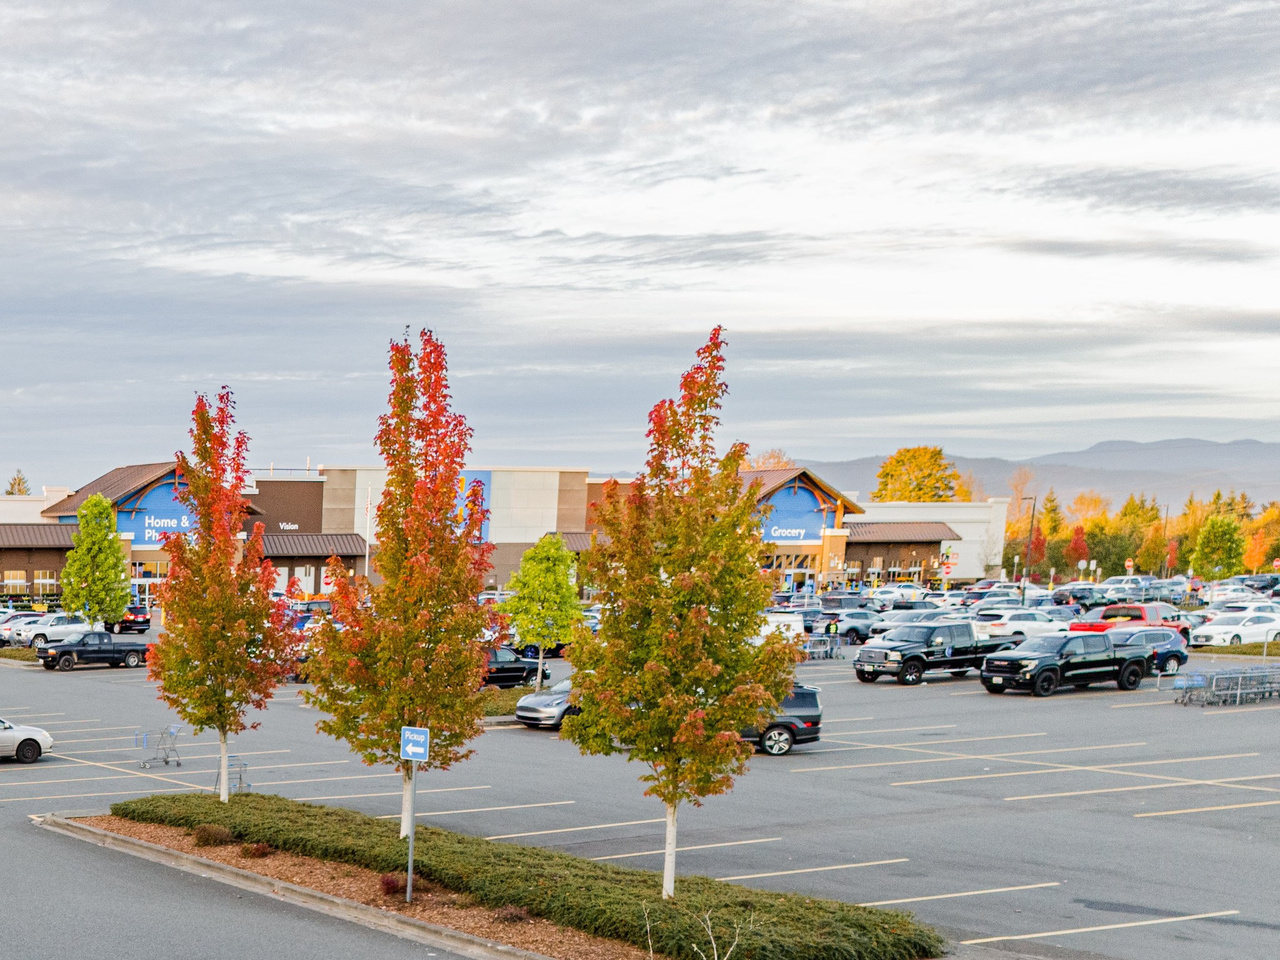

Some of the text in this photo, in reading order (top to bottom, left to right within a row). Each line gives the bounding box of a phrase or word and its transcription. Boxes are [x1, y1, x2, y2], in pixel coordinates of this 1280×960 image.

[145, 515, 190, 528] Home &
[279, 522, 299, 530] Vision
[771, 526, 805, 540] Grocery
[404, 730, 426, 744] Pickup
